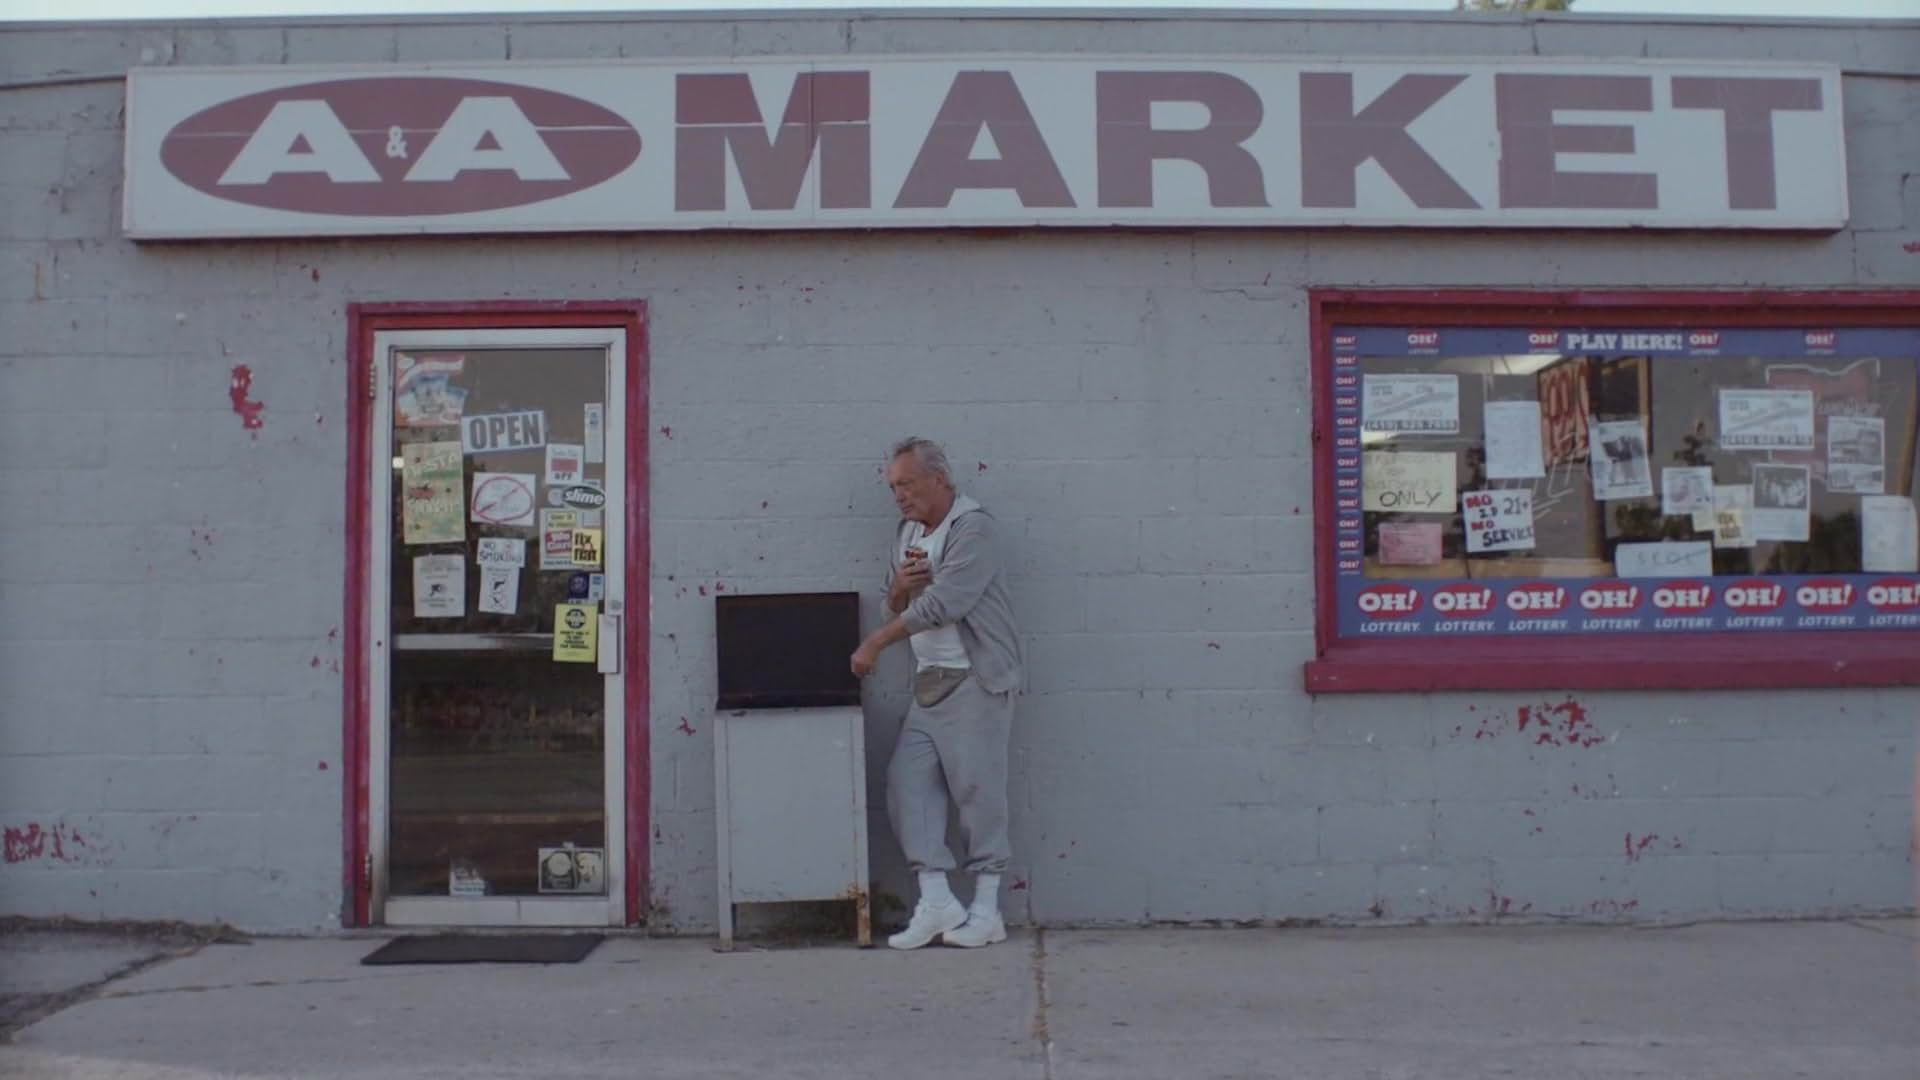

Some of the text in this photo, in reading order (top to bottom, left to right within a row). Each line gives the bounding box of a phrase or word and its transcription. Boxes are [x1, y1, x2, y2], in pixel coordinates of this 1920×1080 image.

[674, 70, 1823, 212] MARKET
[1567, 333, 1683, 350] PLAY HERE!
[469, 413, 541, 450] OPEN
[565, 488, 604, 505] slime
[1379, 489, 1441, 508] ONLY
[1358, 589, 1417, 612] OH!
[1433, 588, 1491, 611] OH!
[1506, 587, 1565, 611] OH!
[1580, 586, 1638, 610] OH!
[1653, 585, 1711, 608] OH!
[1724, 585, 1781, 607] OH!
[1796, 583, 1852, 606] OH!
[1360, 622, 1420, 633] LOTTERY
[1435, 621, 1493, 632] LOTTERY
[1509, 620, 1568, 631] LOTTERY
[1582, 619, 1641, 630] LOTTERY
[1655, 617, 1712, 628] LOTTERY
[1726, 616, 1783, 627] LOTTERY
[1798, 615, 1855, 626] LOTTERY
[1869, 614, 1920, 625] LOTTER
